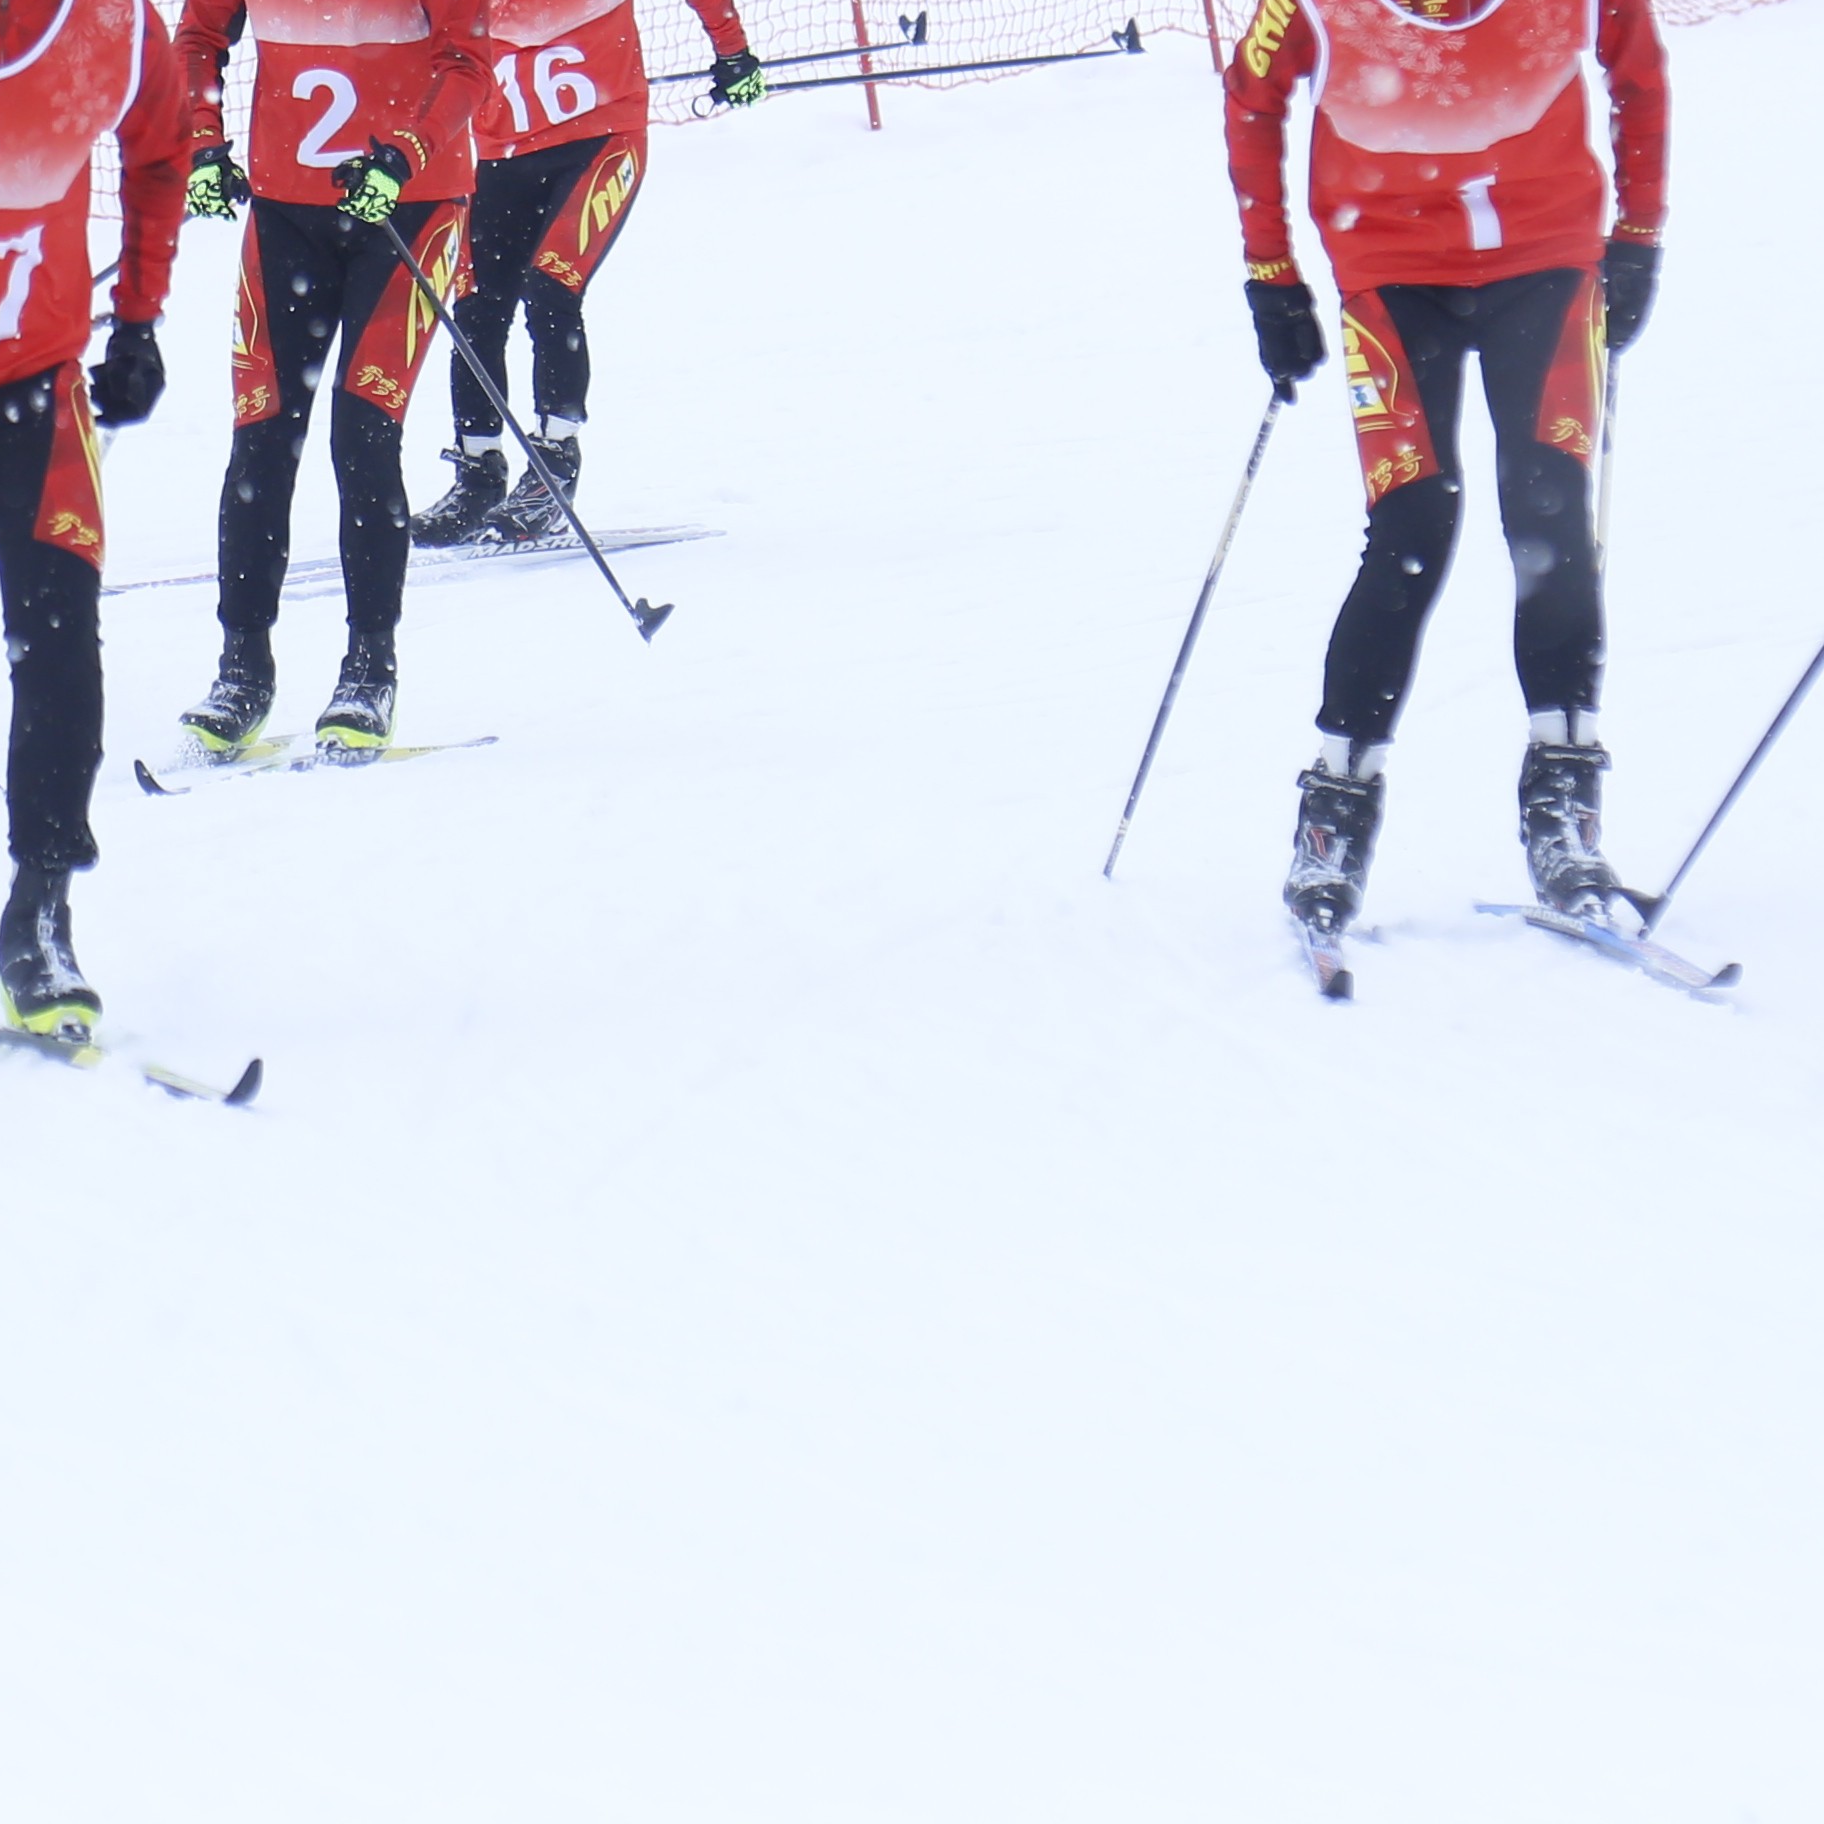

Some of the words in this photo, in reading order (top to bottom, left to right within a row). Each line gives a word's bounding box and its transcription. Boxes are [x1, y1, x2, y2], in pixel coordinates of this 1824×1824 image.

[292, 68, 365, 168] 2
[492, 45, 597, 134] 16
[1457, 174, 1503, 252] 1
[472, 531, 605, 558] MADSHU
